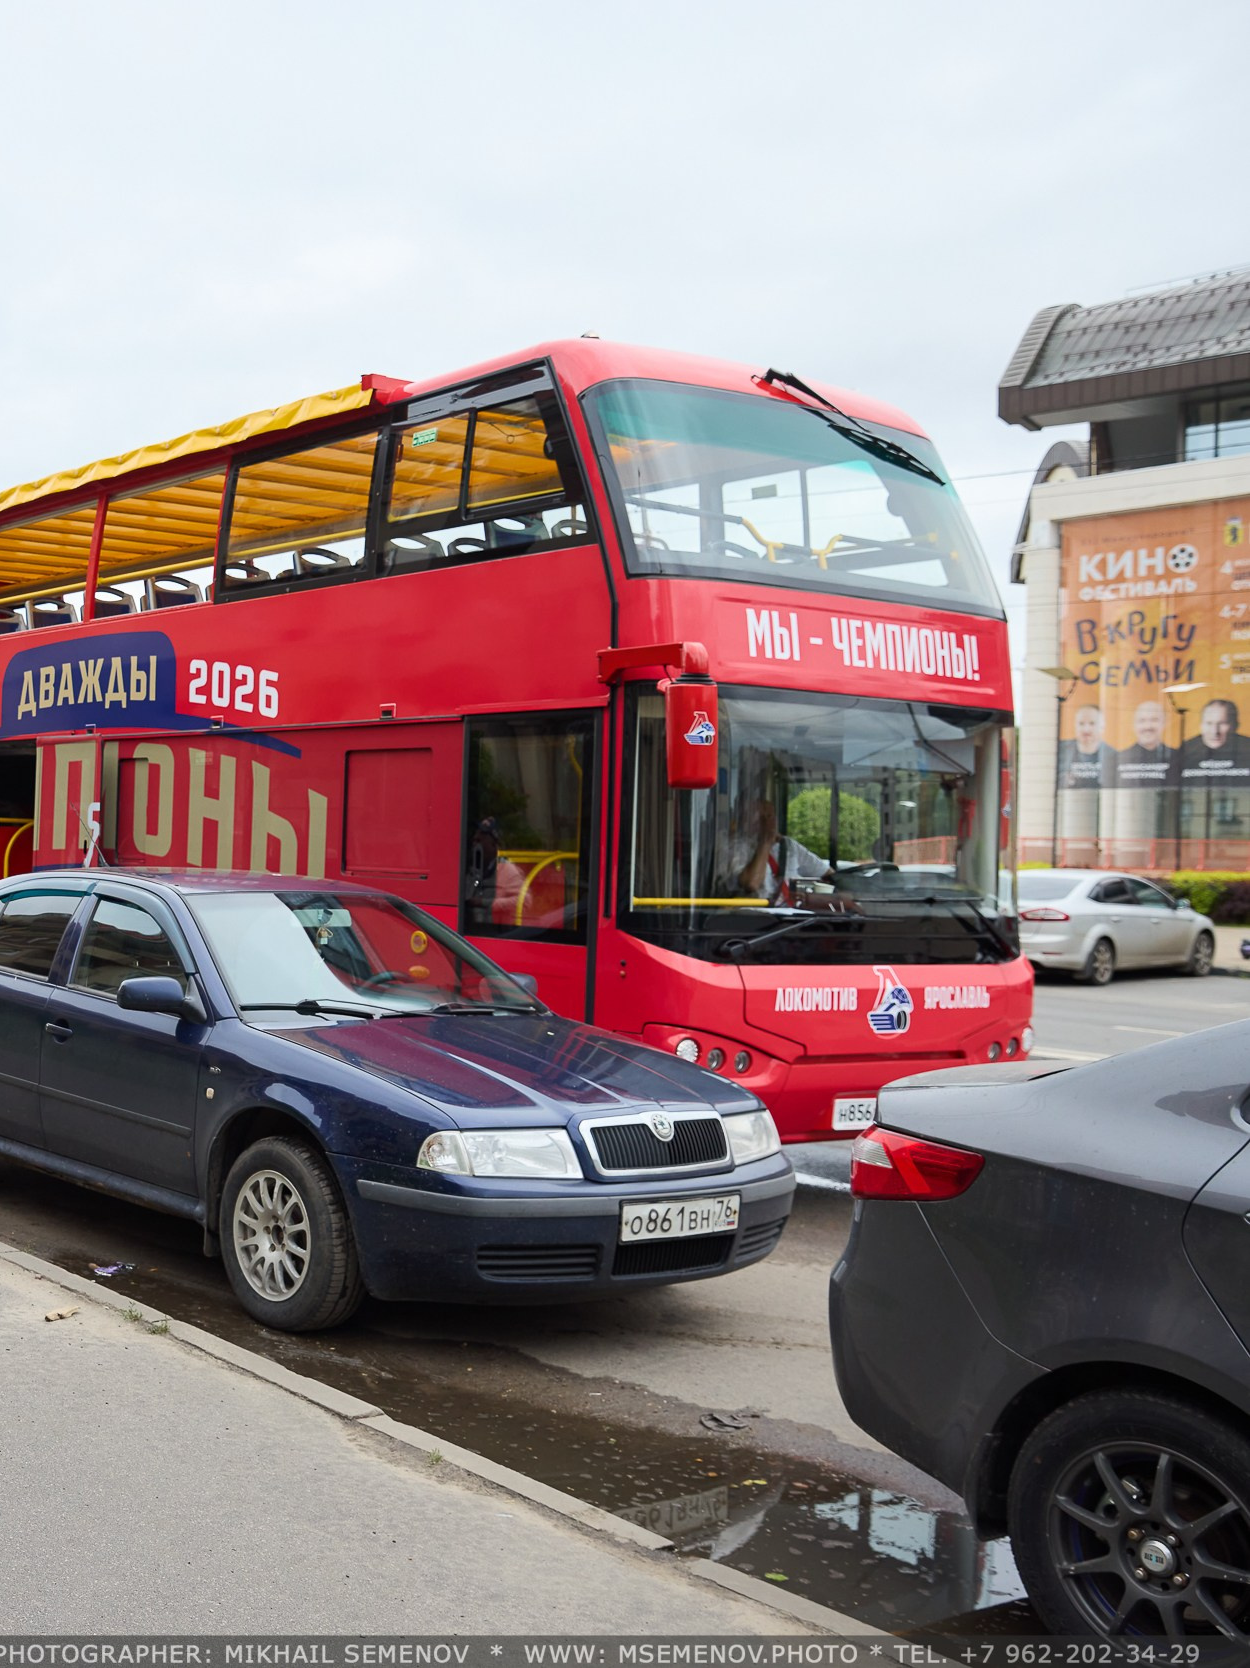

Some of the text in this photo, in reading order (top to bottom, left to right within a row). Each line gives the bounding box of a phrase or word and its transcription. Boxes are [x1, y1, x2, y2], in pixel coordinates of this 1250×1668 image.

[1078, 576, 1198, 602] ФЕСТИВАЛЬ
[745, 607, 801, 661] МЫ
[830, 616, 981, 681] ЧЕМПИОНЫ!
[1075, 618, 1098, 655] В
[17, 655, 158, 720] ДВАЖДЫ
[188, 658, 280, 719] 2026
[774, 986, 991, 1012] ЛОКОМОТИВ ЯРОСЛАВЛЬ
[630, 1199, 733, 1235] О861ВН 76
